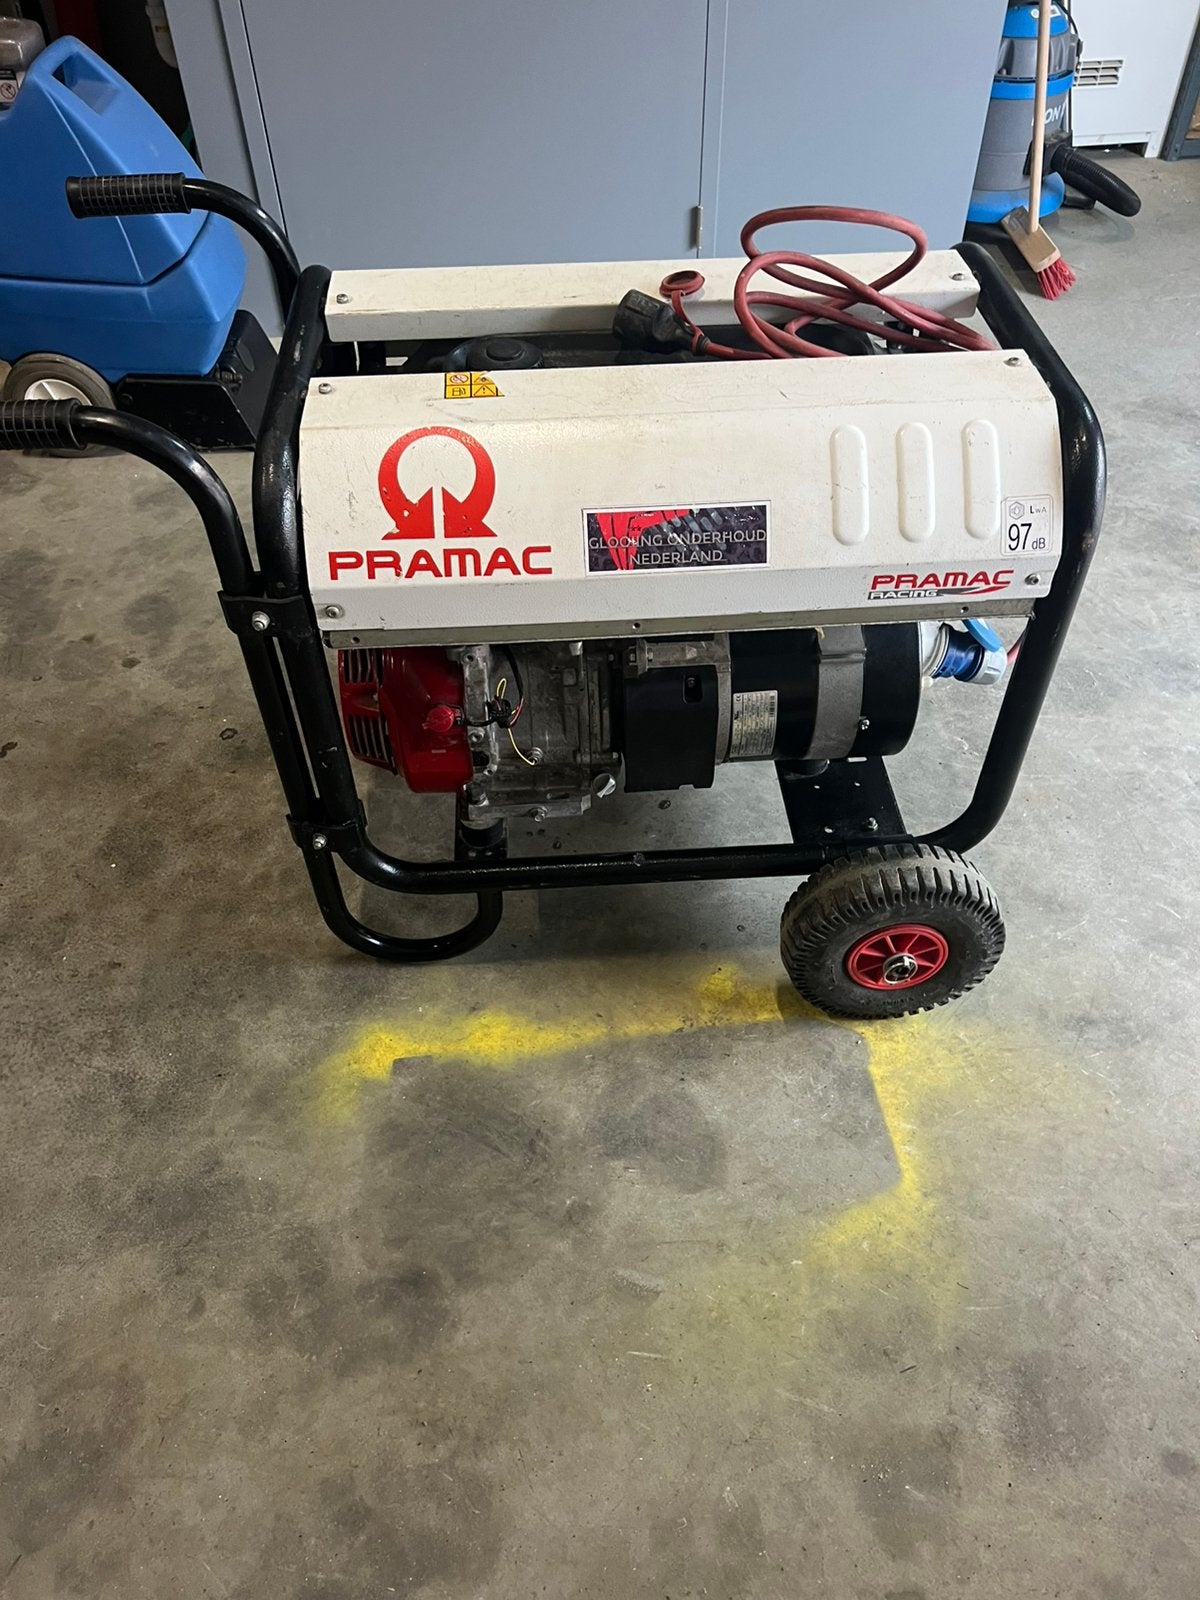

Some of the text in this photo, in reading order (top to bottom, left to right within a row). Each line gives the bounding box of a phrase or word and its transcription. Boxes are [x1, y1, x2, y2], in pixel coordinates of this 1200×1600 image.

[667, 529, 767, 547] ONDERHOUD
[1008, 523, 1046, 551] 97 dB
[328, 545, 553, 580] PRAMAC
[629, 549, 723, 565] NEDERLAND
[871, 570, 1014, 590] PRAMAC
[870, 590, 938, 599] RACING
